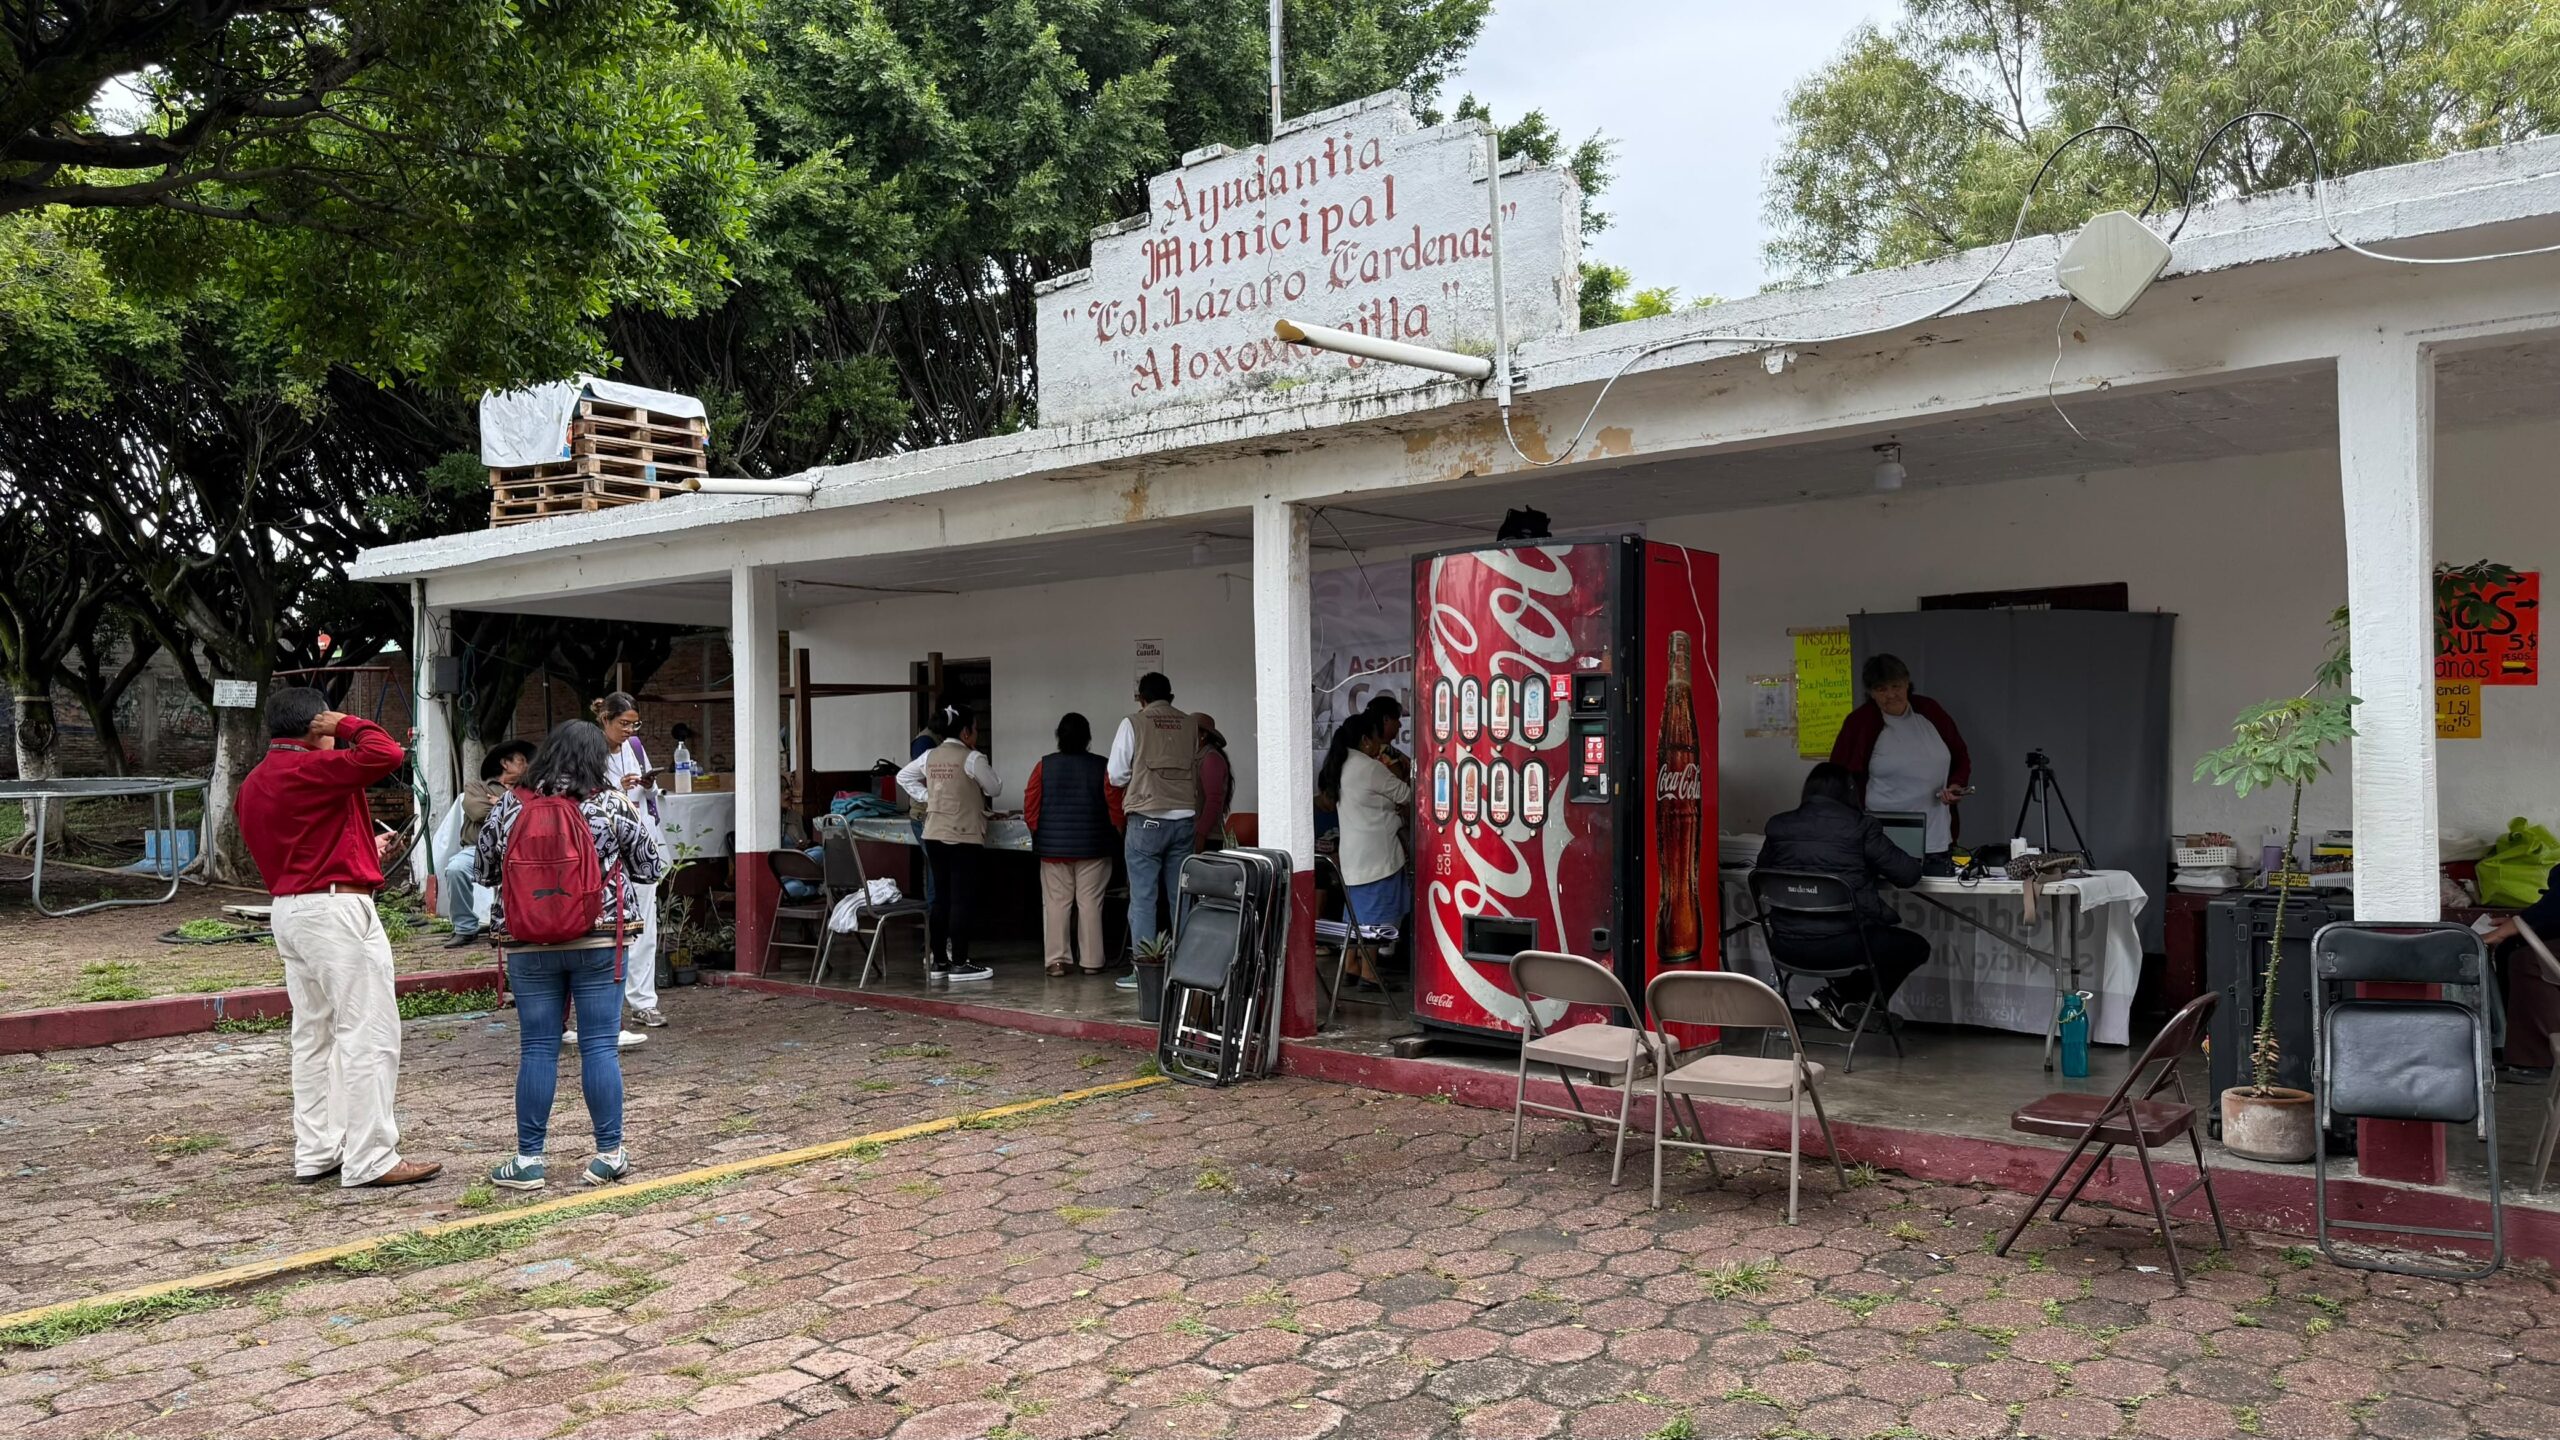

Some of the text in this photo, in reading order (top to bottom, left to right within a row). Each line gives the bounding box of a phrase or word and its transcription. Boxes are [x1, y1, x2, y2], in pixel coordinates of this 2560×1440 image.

[1141, 174, 1398, 290] Municipal
[2435, 684, 2471, 696] ende
[1443, 843, 1451, 876] cold
